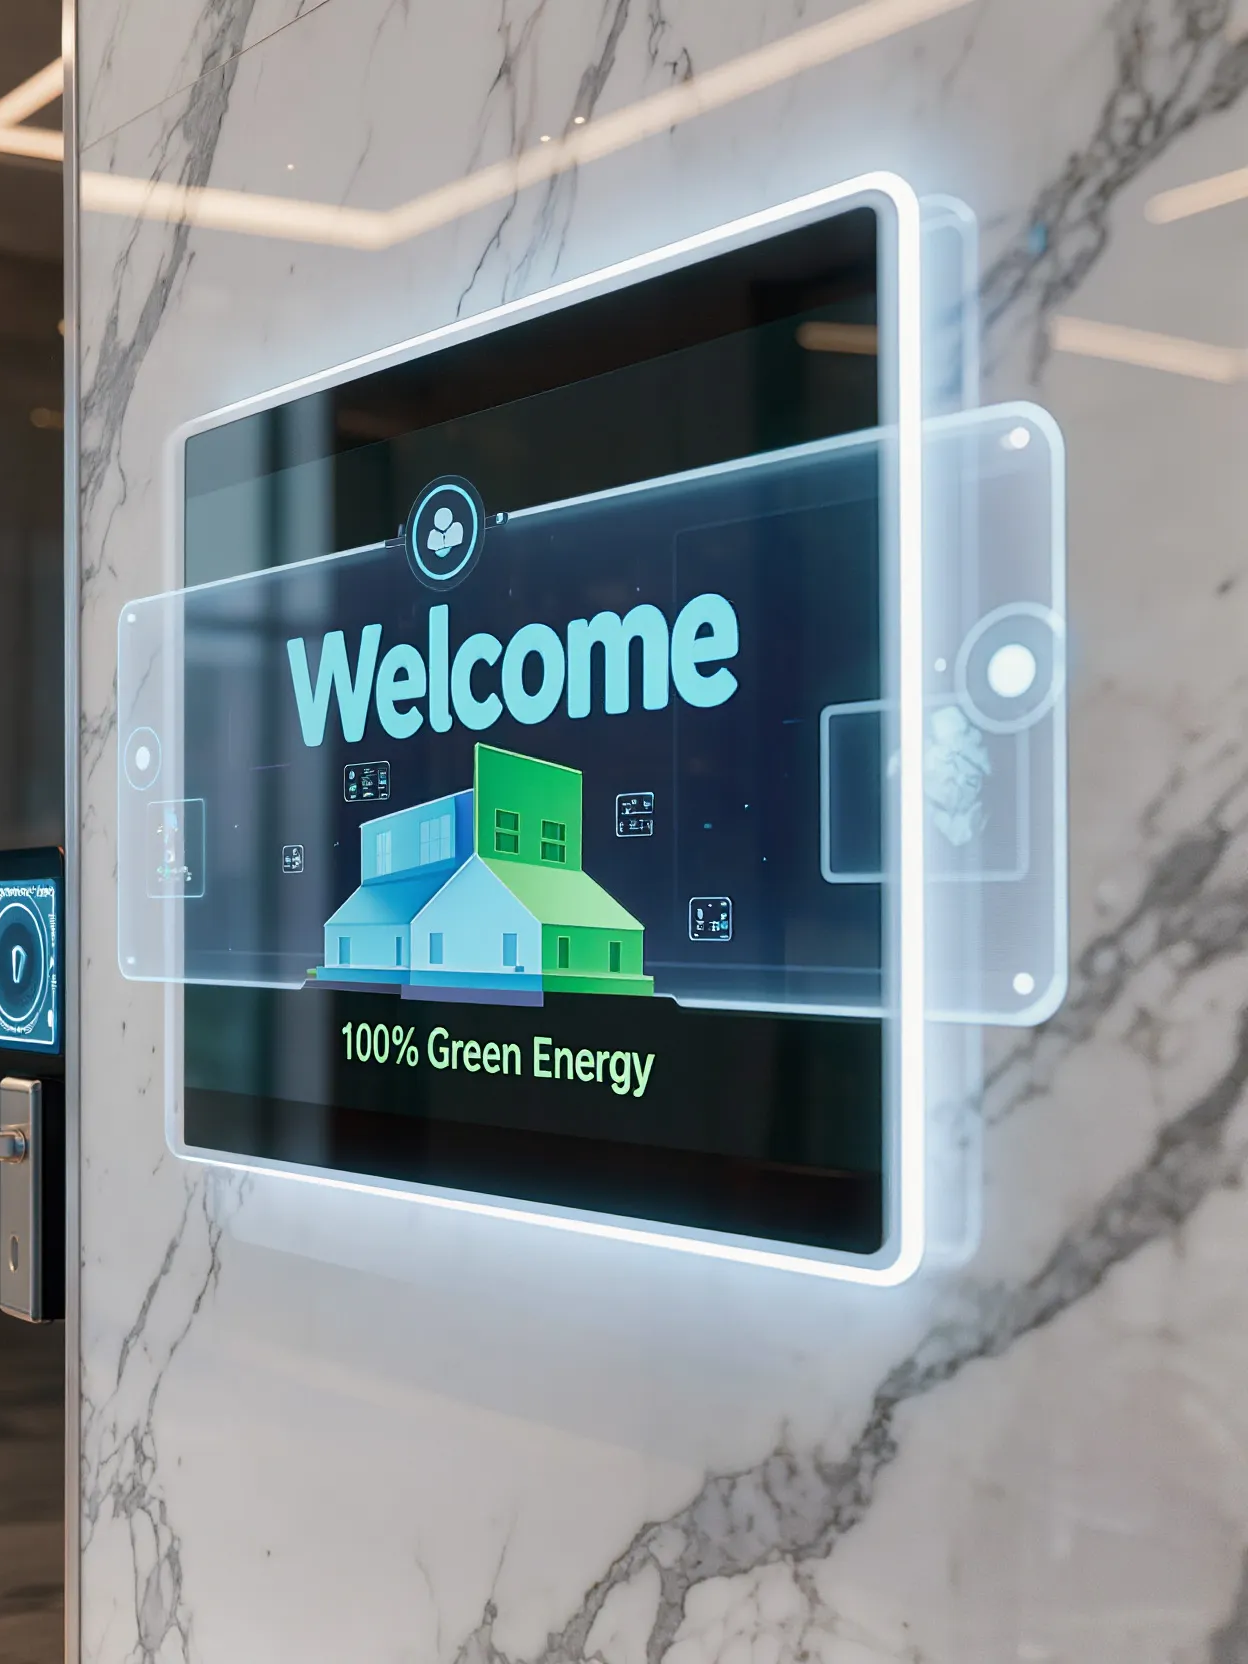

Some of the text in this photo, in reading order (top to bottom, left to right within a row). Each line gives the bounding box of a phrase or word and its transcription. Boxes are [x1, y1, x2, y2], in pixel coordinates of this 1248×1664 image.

[286, 593, 739, 748] Welcome
[341, 1021, 656, 1098] 100% Green Energy
